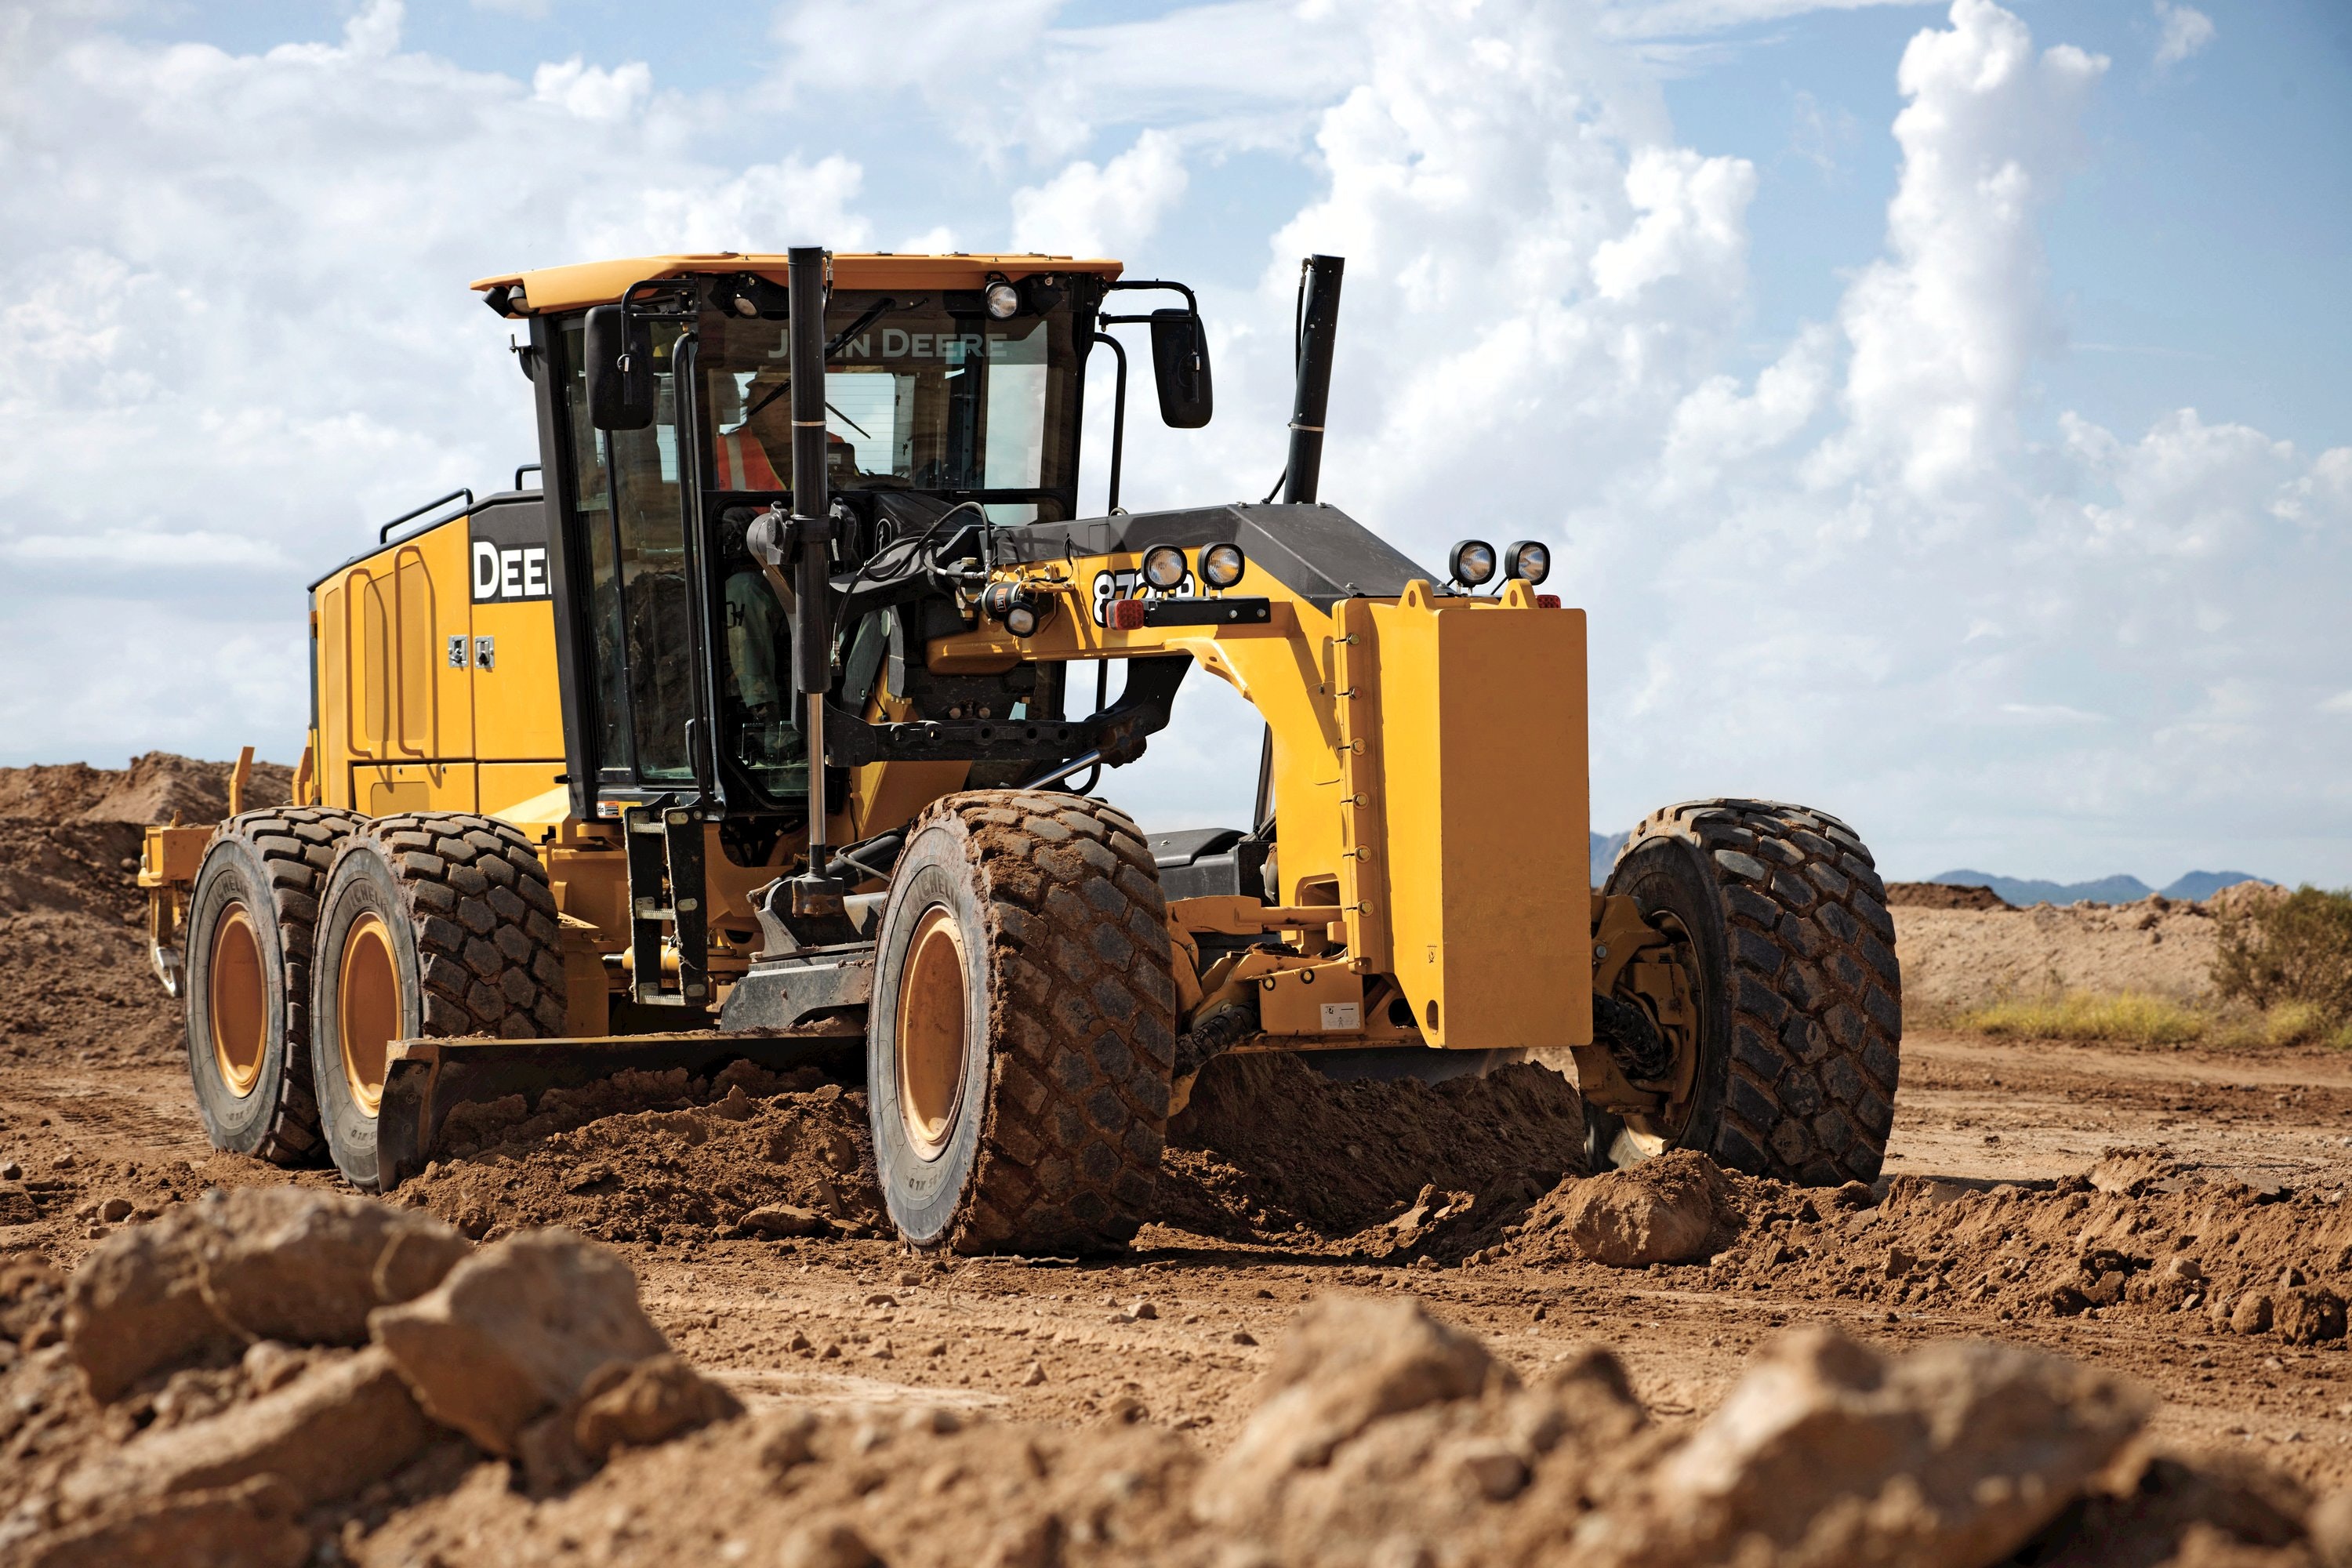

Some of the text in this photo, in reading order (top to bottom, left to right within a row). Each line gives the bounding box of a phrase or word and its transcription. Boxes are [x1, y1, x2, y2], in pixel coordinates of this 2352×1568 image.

[768, 328, 1007, 358] JHN DEERE
[473, 541, 552, 599] DEE
[208, 875, 251, 916] ICHELIN
[343, 883, 390, 924] ICHELIN
[905, 871, 960, 920] ICHELIN
